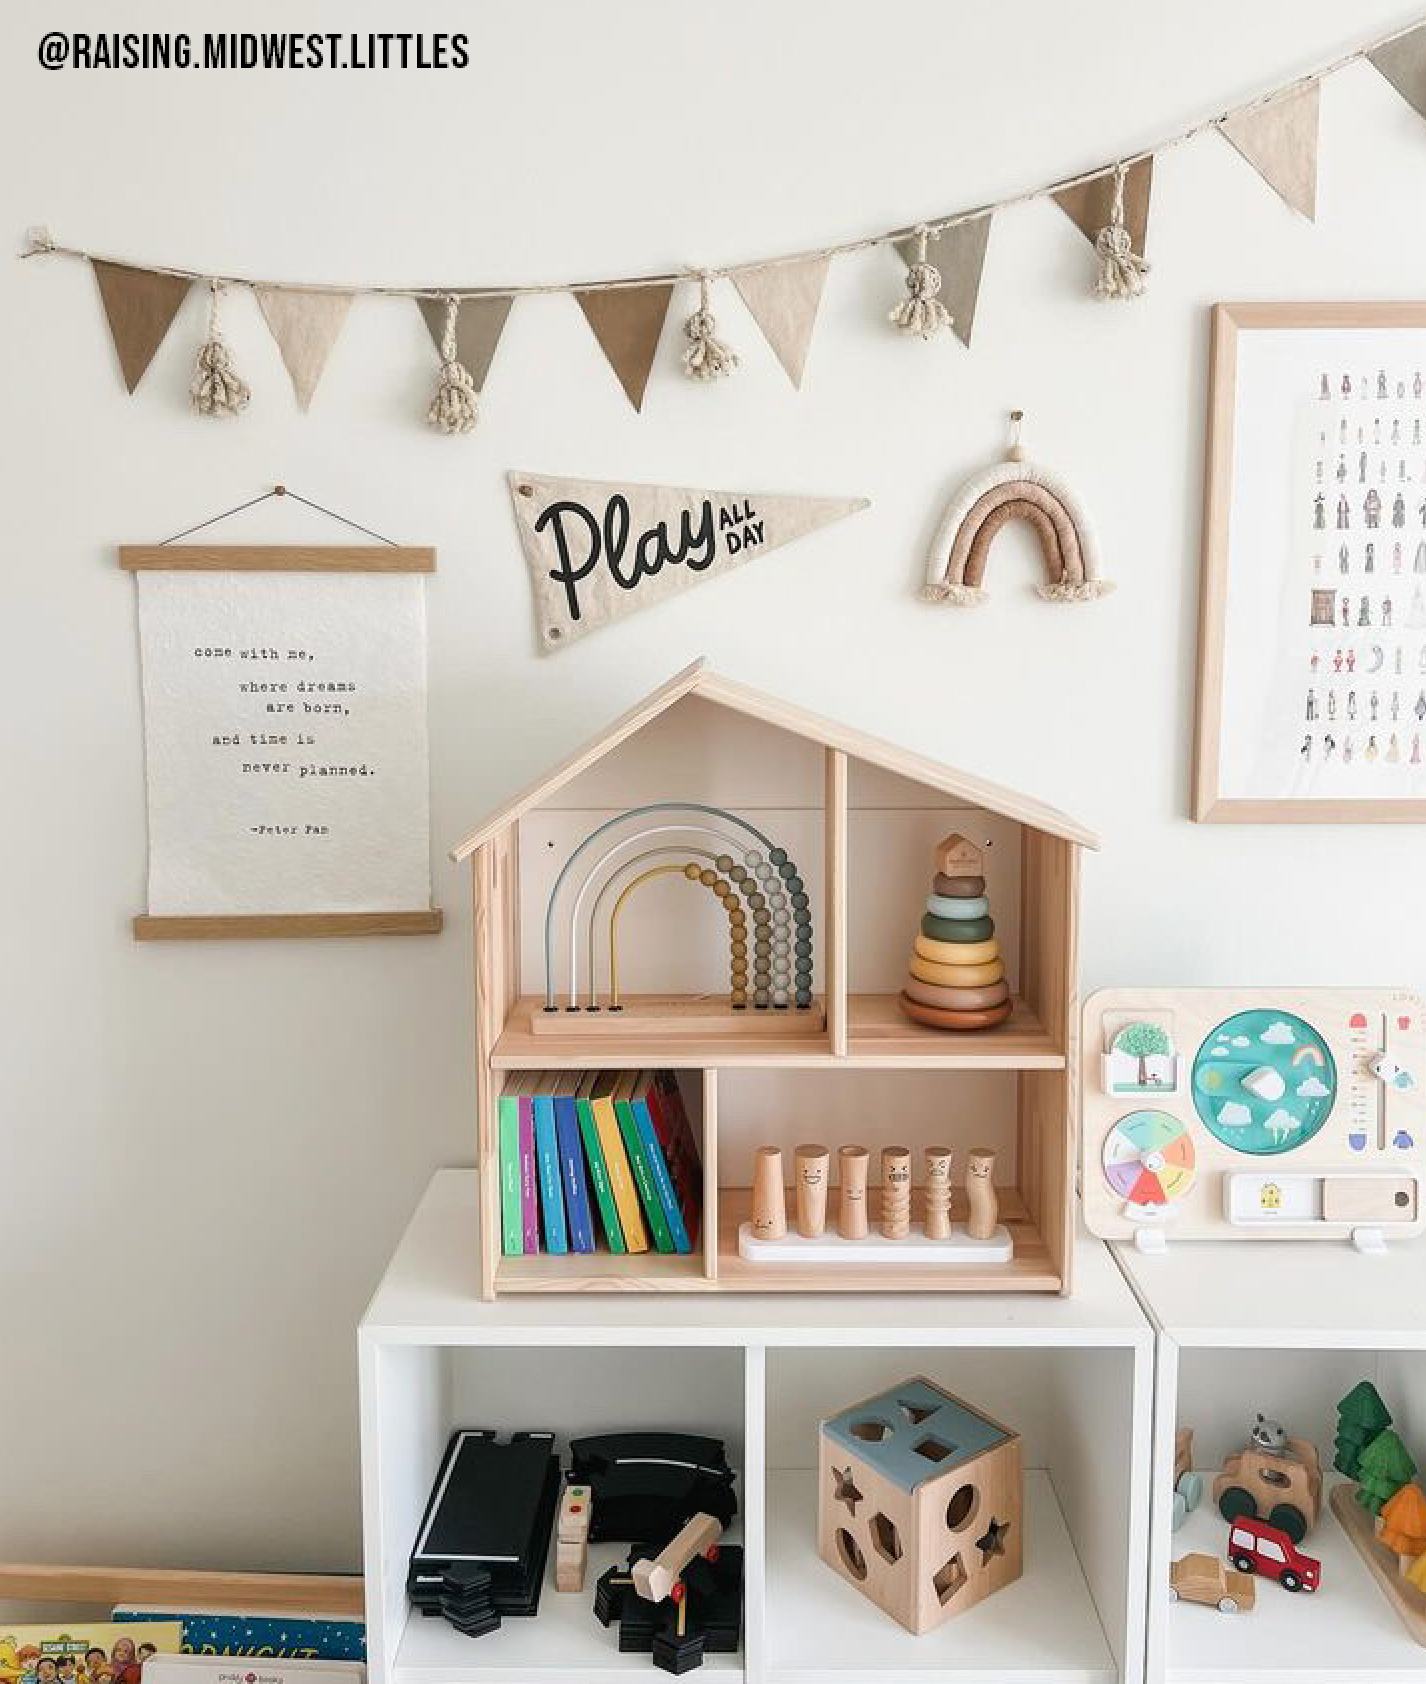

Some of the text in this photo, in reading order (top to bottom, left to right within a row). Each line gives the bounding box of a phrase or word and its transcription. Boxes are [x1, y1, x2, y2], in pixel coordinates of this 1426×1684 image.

[718, 500, 756, 531] ALL
[727, 521, 764, 554] DAY
[535, 494, 715, 621] Play
[194, 646, 315, 662] come with me,
[238, 680, 357, 693] where dreams
[266, 701, 351, 716] are born,
[211, 734, 316, 745] and time is
[242, 762, 375, 778] never planned.
[304, 825, 330, 836] Pan
